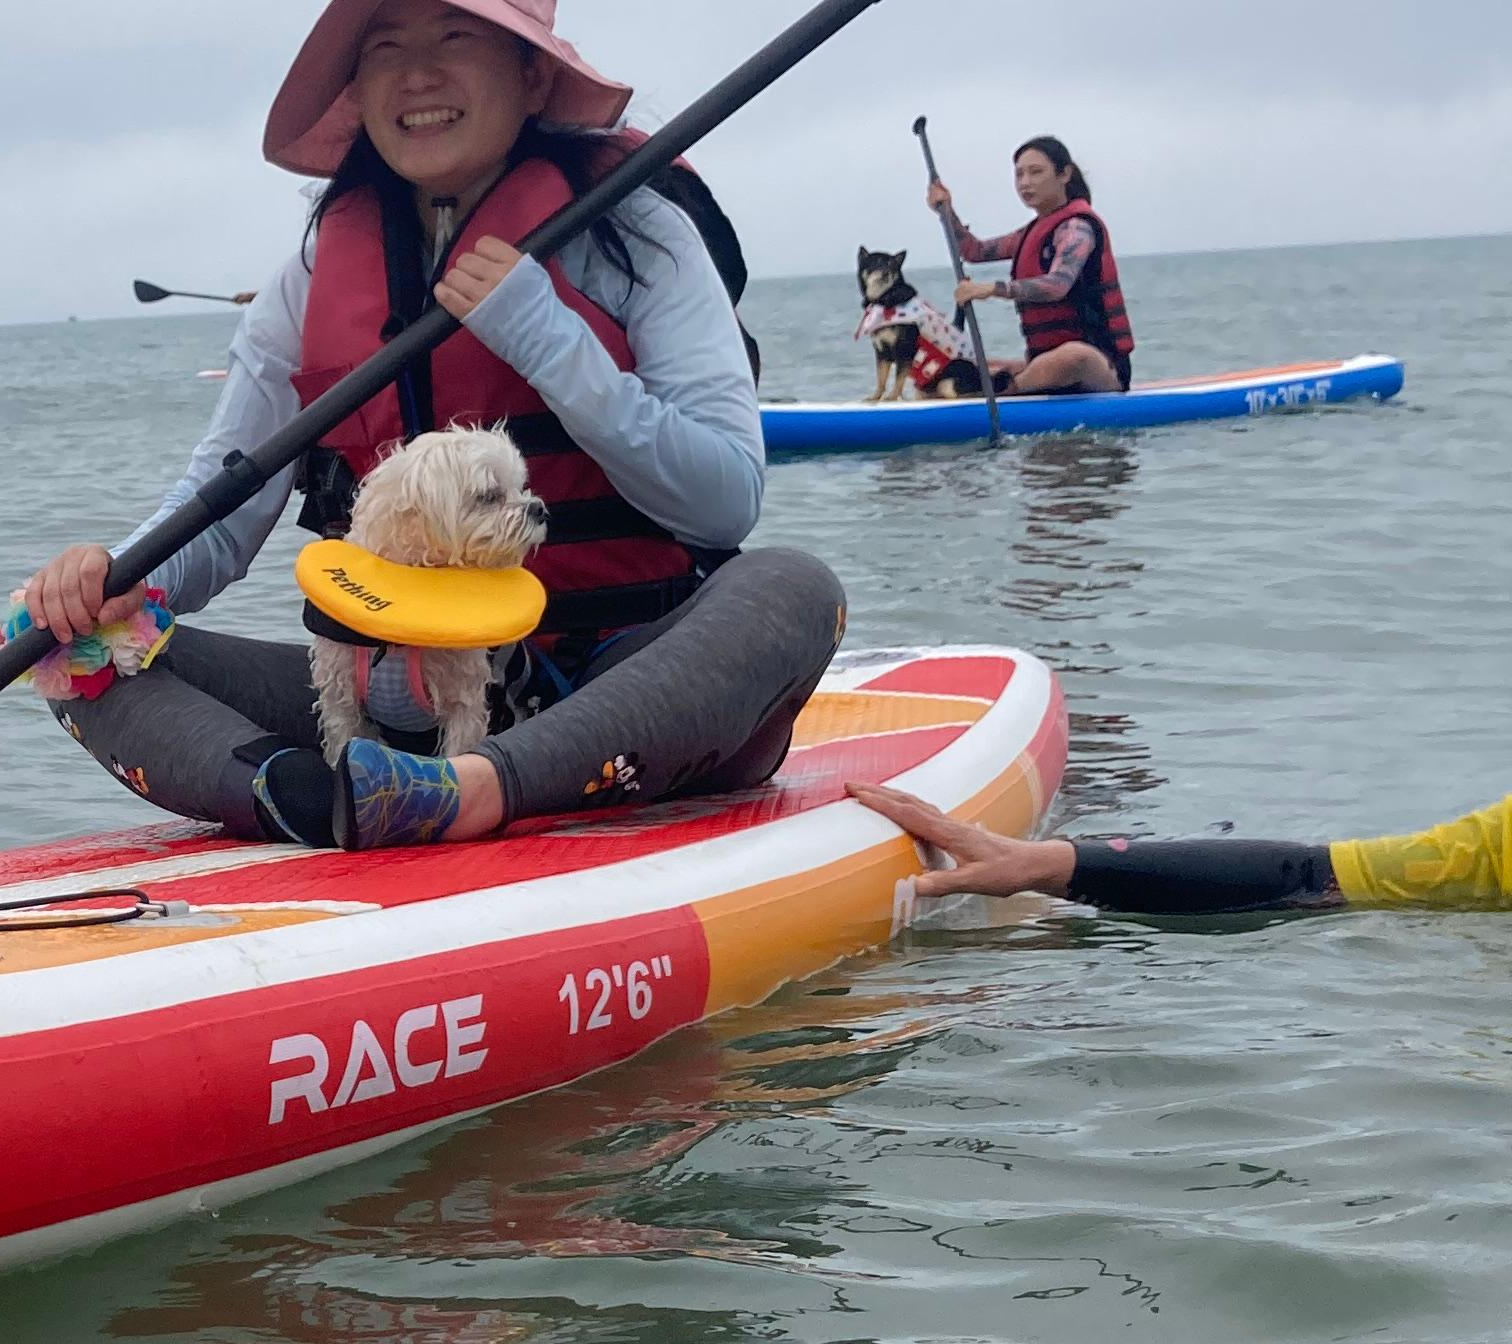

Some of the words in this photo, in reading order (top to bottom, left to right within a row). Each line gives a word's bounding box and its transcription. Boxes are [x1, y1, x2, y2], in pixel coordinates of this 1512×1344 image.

[321, 567, 393, 612] Pething
[268, 993, 489, 1125] RACE
[558, 955, 673, 1035] 12'6"
